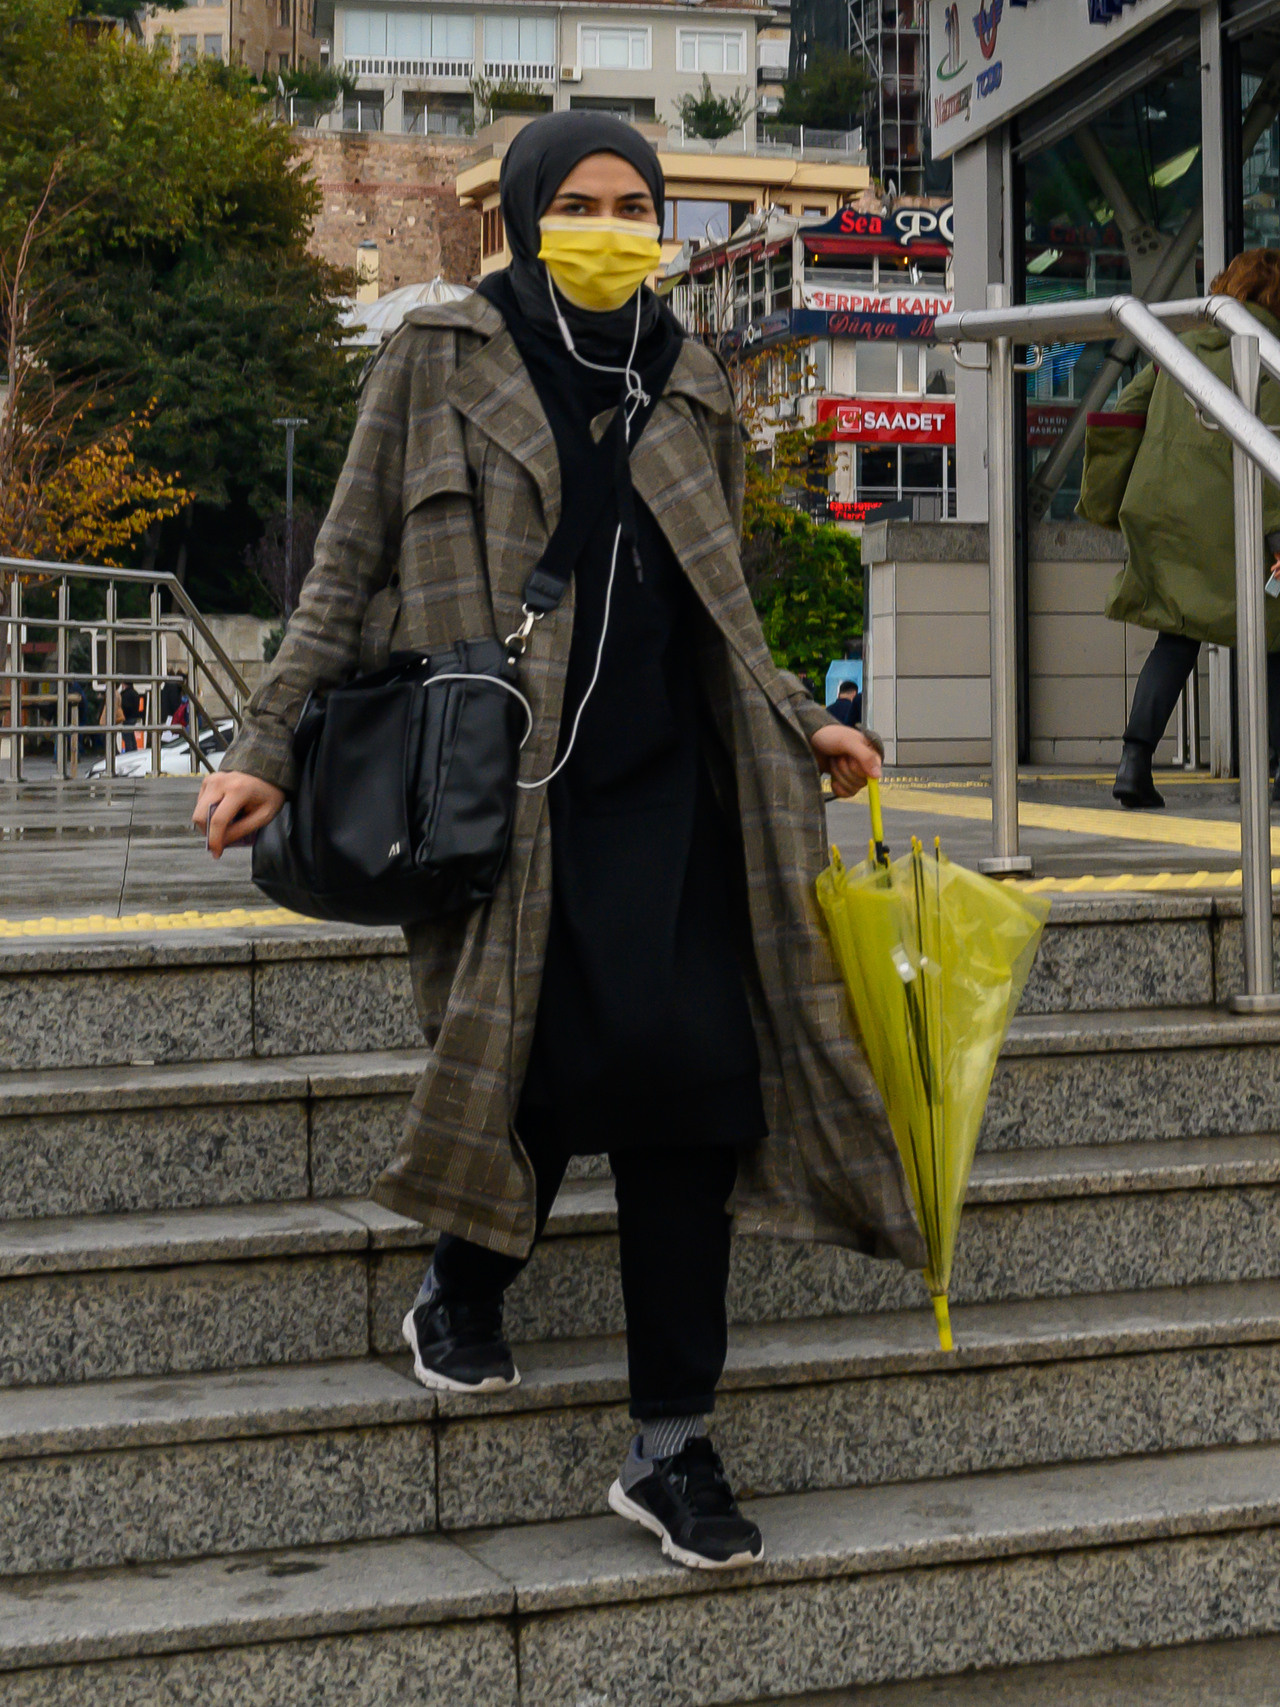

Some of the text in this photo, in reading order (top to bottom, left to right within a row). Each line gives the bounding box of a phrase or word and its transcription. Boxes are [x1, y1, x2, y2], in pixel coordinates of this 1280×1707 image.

[840, 209, 882, 234] Sea
[813, 292, 892, 313] SERPME
[828, 313, 897, 341] Dünya
[864, 412, 946, 432] SAADET
